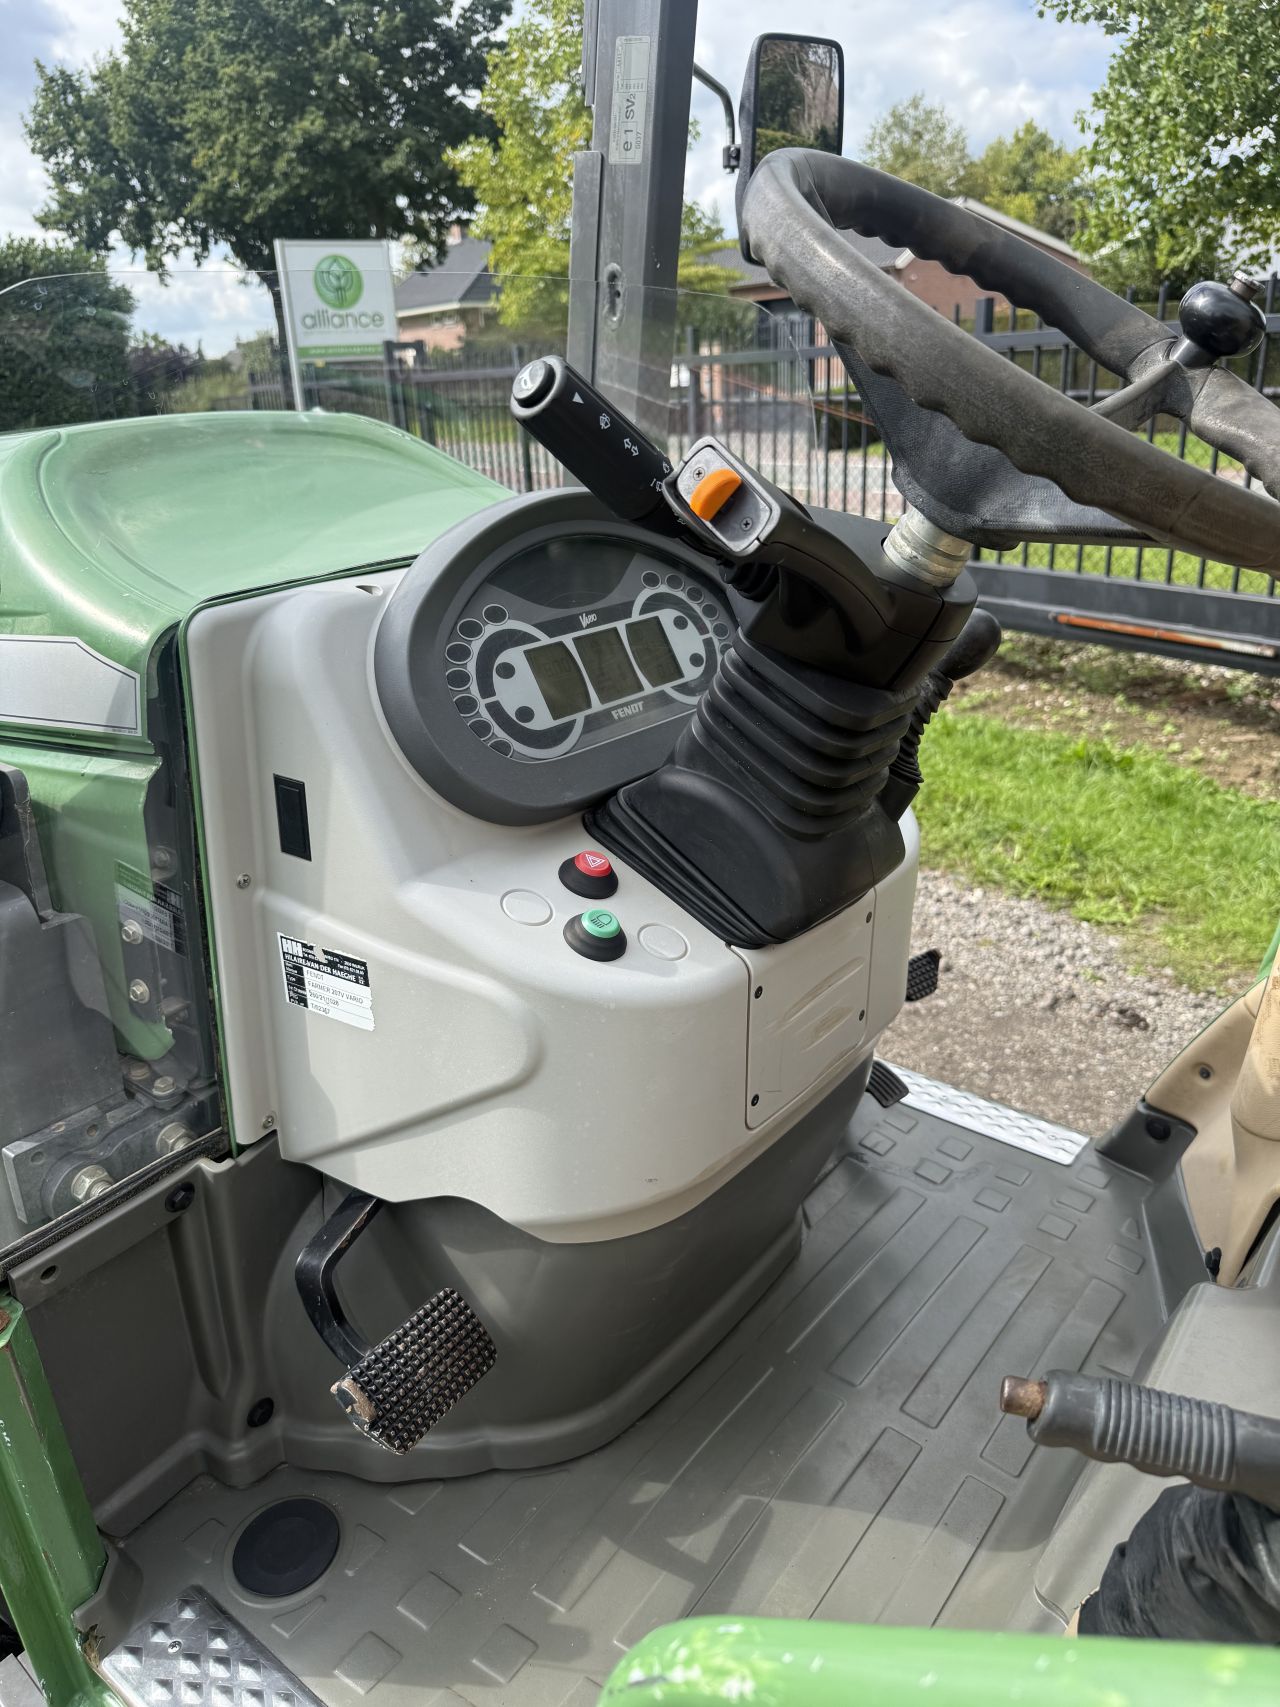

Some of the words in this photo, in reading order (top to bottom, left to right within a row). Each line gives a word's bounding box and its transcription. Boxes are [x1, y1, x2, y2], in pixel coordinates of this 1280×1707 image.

[301, 309, 385, 329] alliance
[611, 701, 644, 720] FENDT
[281, 937, 303, 958] HH
[320, 964, 332, 974] DER
